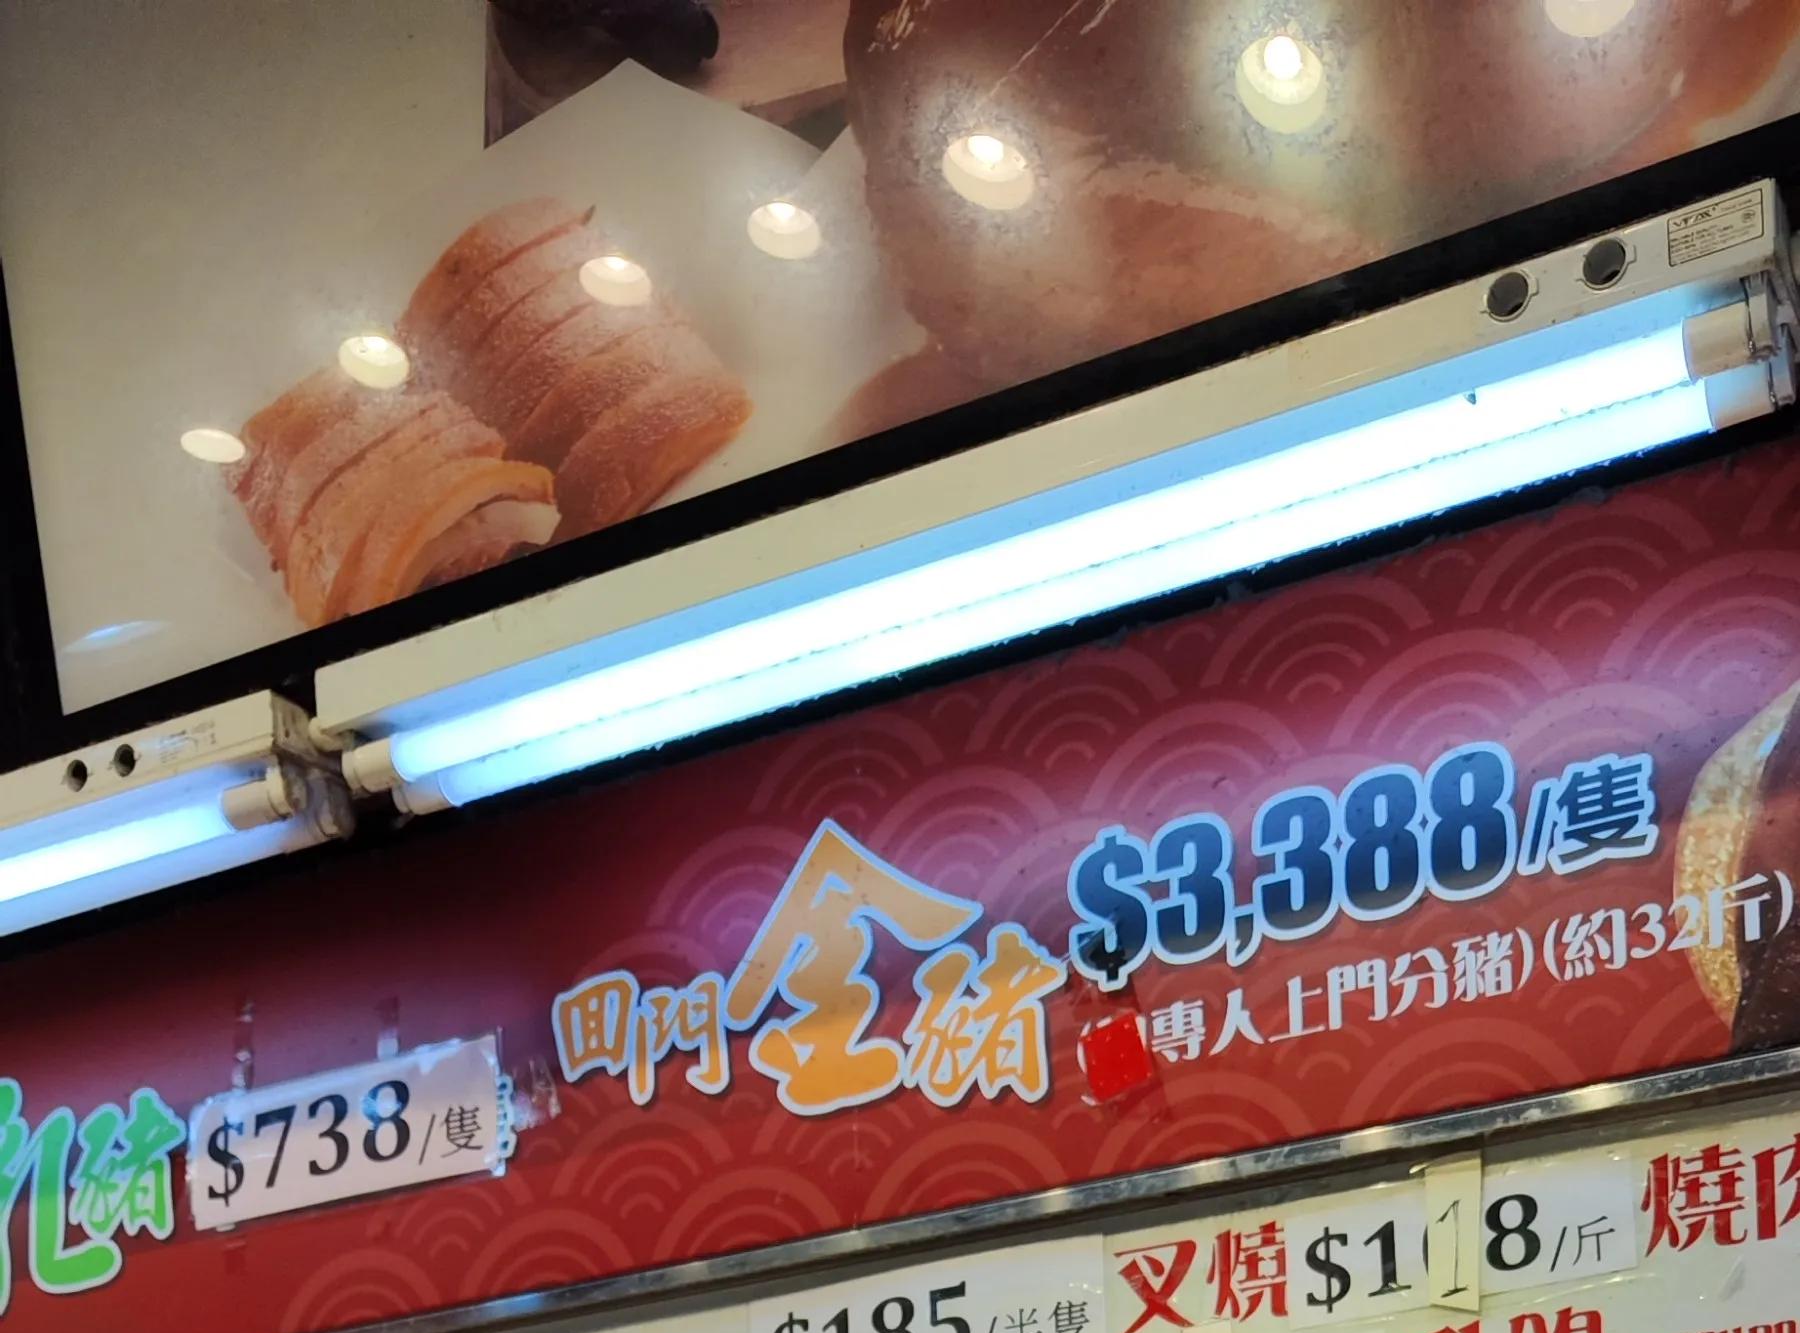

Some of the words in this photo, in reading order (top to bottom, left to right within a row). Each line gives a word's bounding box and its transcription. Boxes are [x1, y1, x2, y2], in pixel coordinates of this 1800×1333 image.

[552, 818, 1068, 1115] 回門金豬
[1068, 742, 1658, 990] $3,388/隻
[207, 1080, 484, 1208] $738/隻
